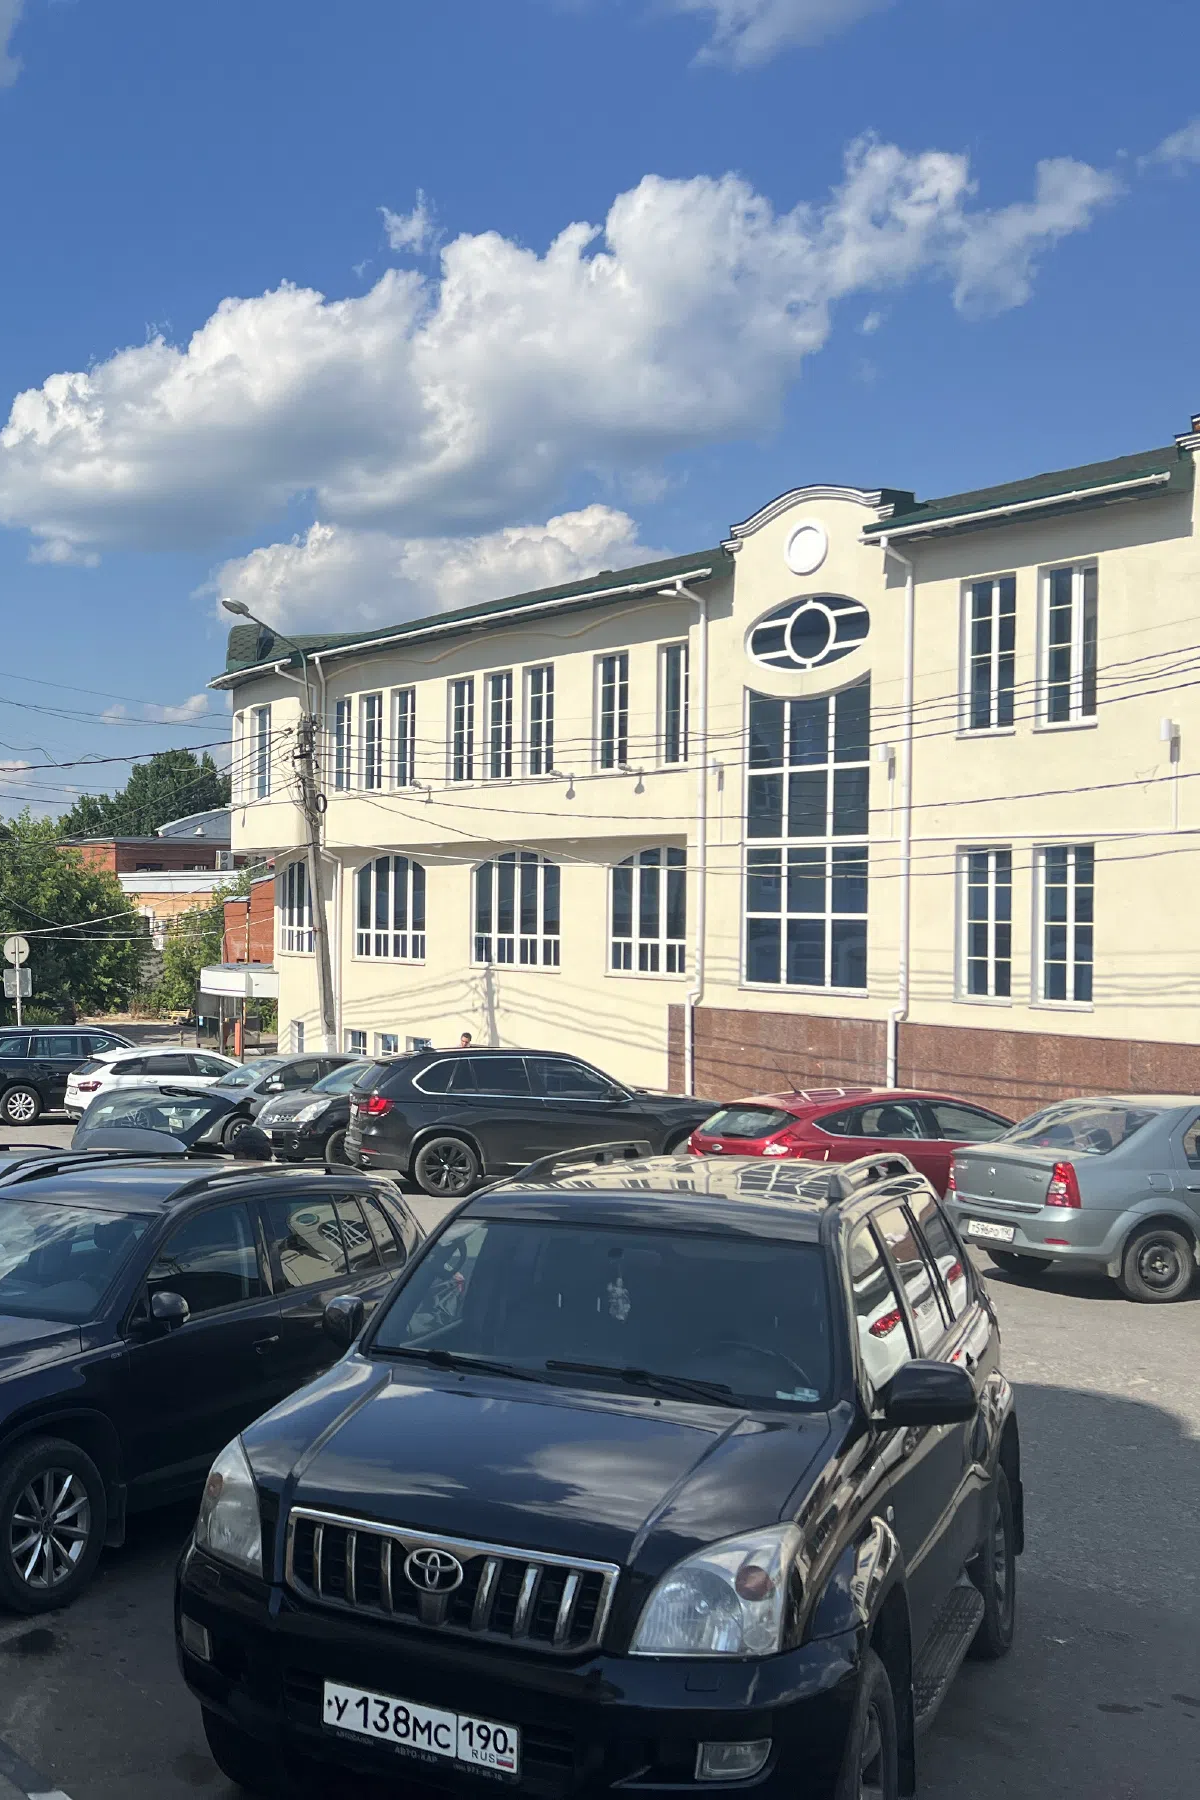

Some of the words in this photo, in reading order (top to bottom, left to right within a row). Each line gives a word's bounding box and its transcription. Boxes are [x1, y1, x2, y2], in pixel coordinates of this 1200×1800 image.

[334, 1695, 451, 1749] У138МС
[461, 1721, 509, 1754] 190
[471, 1748, 496, 1763] RUS
